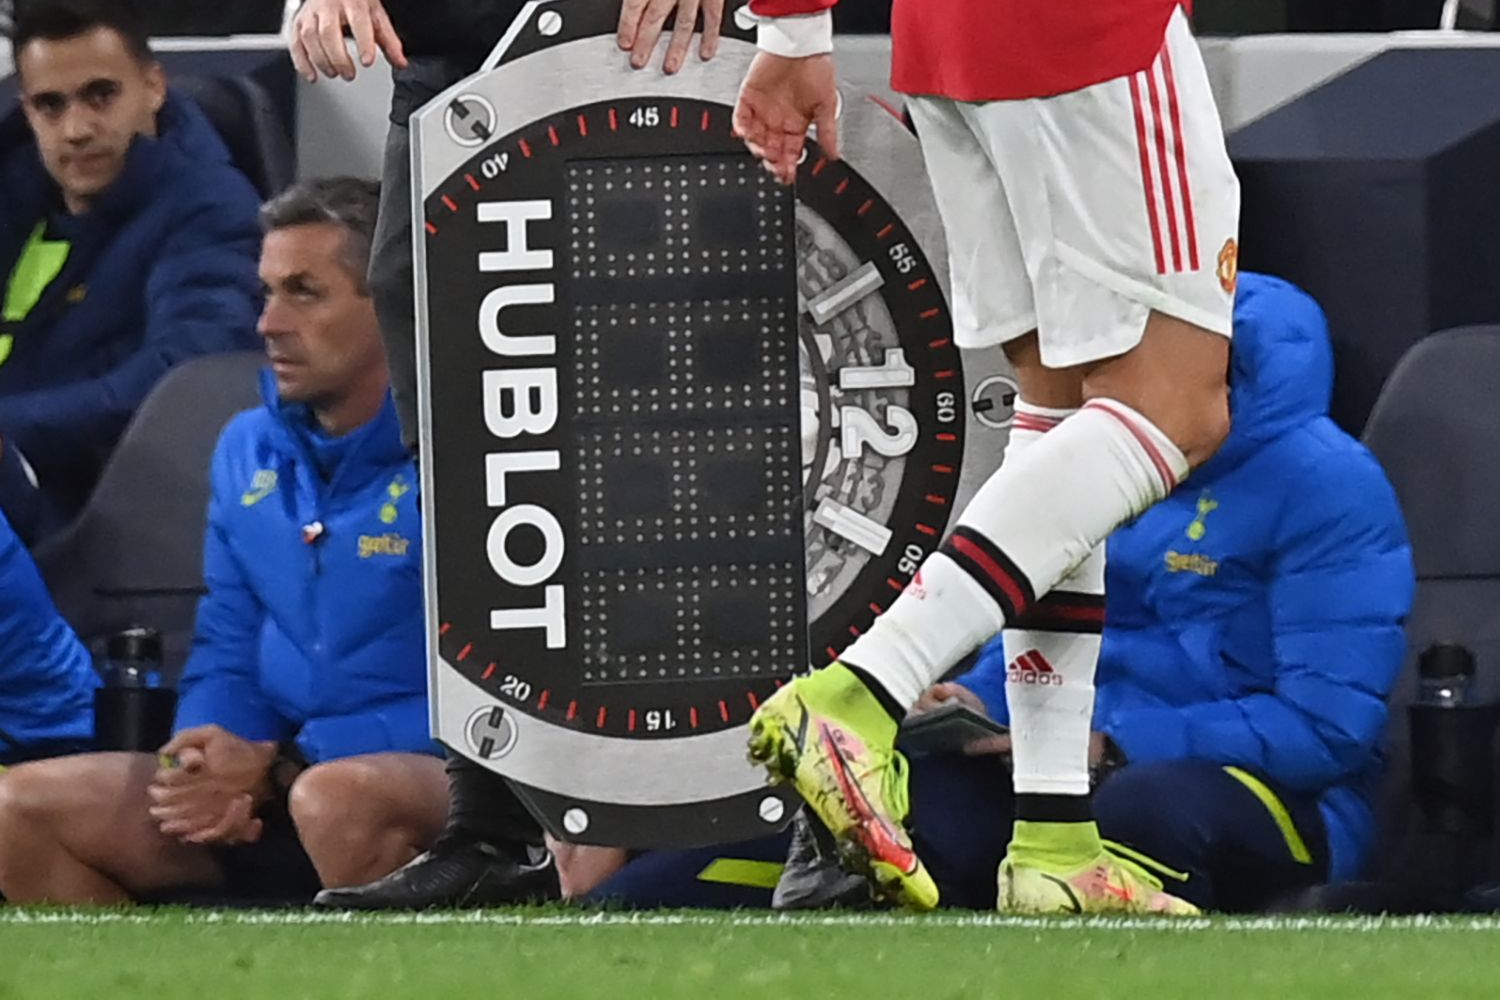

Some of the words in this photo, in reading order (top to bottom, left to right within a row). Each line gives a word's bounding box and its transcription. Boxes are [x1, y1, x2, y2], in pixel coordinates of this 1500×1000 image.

[629, 106, 660, 127] 45
[481, 152, 509, 179] 40
[888, 242, 917, 274] 55
[839, 347, 919, 459] 12
[936, 392, 956, 423] 60
[476, 199, 567, 649] HUBLOT
[897, 544, 924, 576] 05
[499, 674, 532, 702] 20
[645, 710, 676, 731] 15
